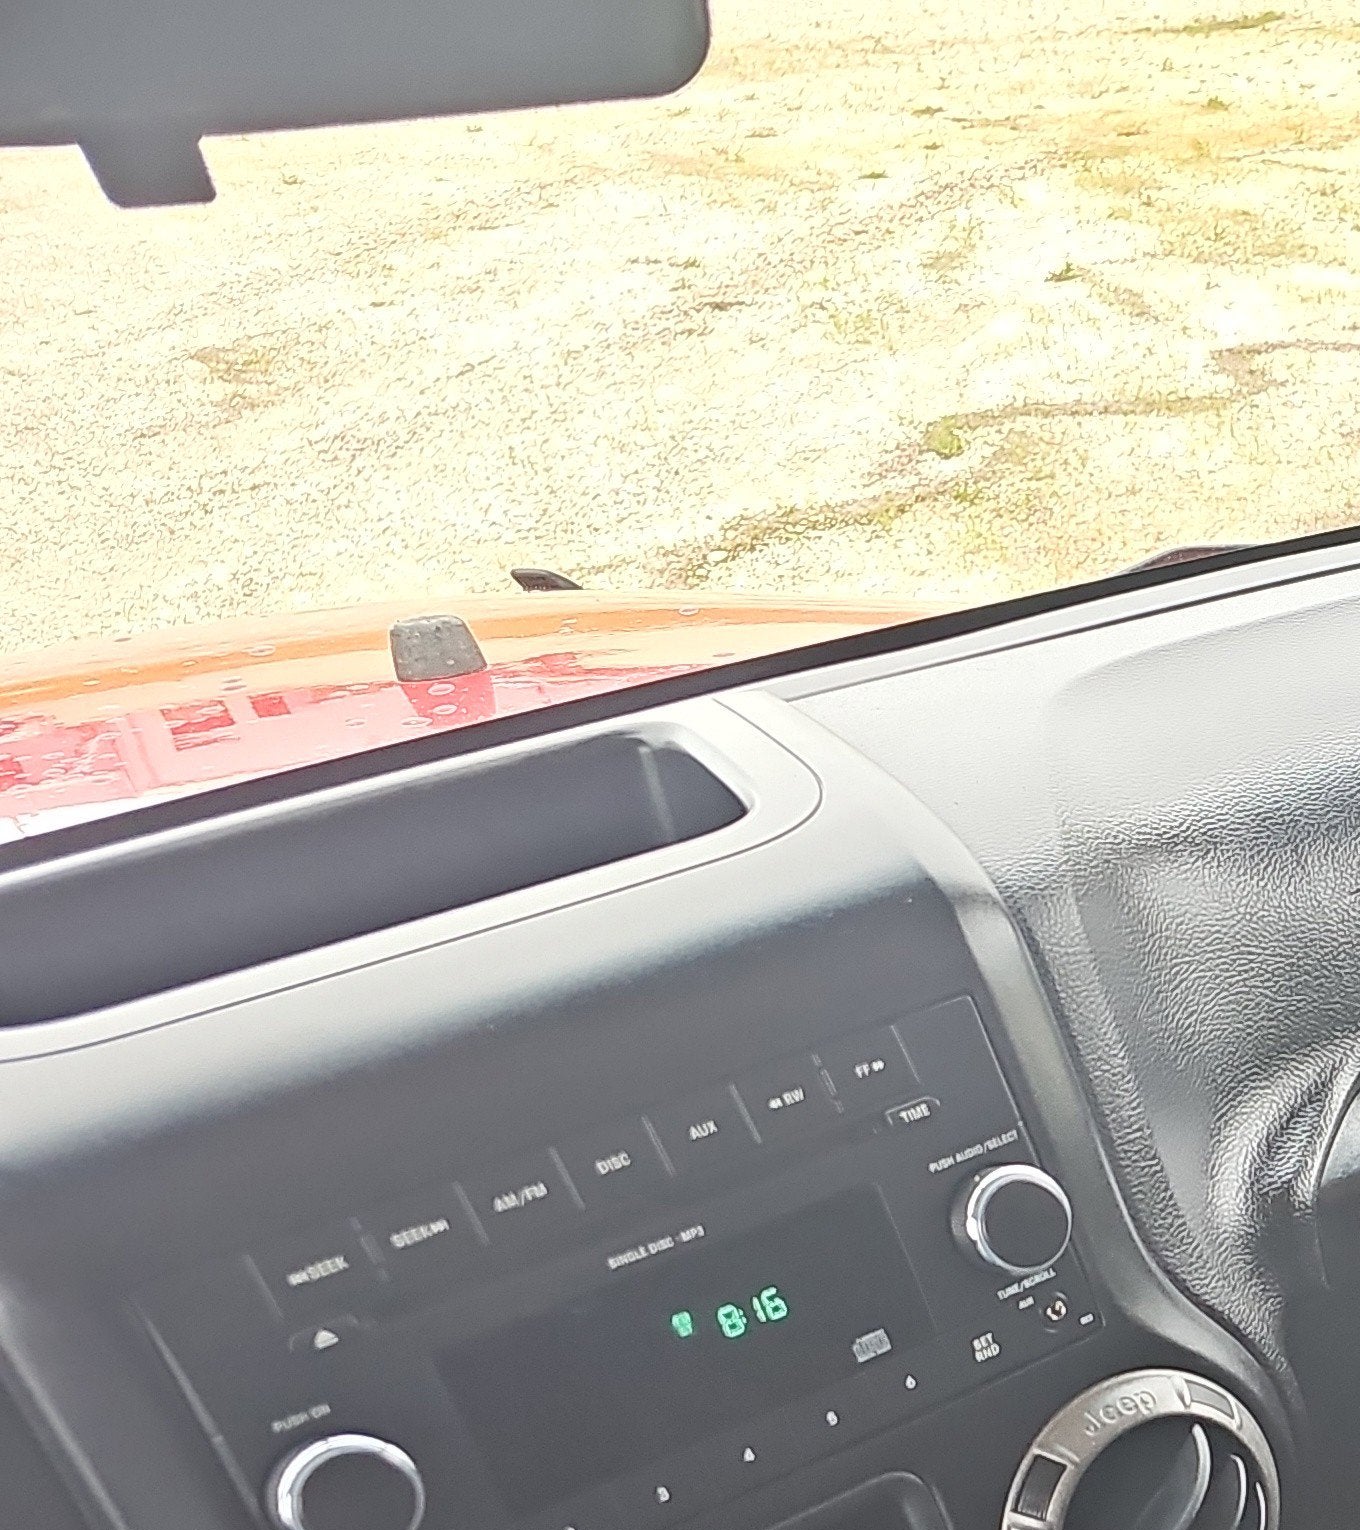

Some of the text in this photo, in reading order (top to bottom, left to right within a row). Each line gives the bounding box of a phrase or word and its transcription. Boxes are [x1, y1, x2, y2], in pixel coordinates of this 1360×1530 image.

[492, 1181, 548, 1213] AM/FM
[595, 1150, 632, 1176] DISC
[689, 1120, 718, 1142] AUX
[782, 1086, 805, 1107] RW
[854, 1061, 871, 1079] FF
[899, 1102, 931, 1123] TIME
[716, 1286, 788, 1339] 8:16
[1083, 1389, 1158, 1437] Jeep
